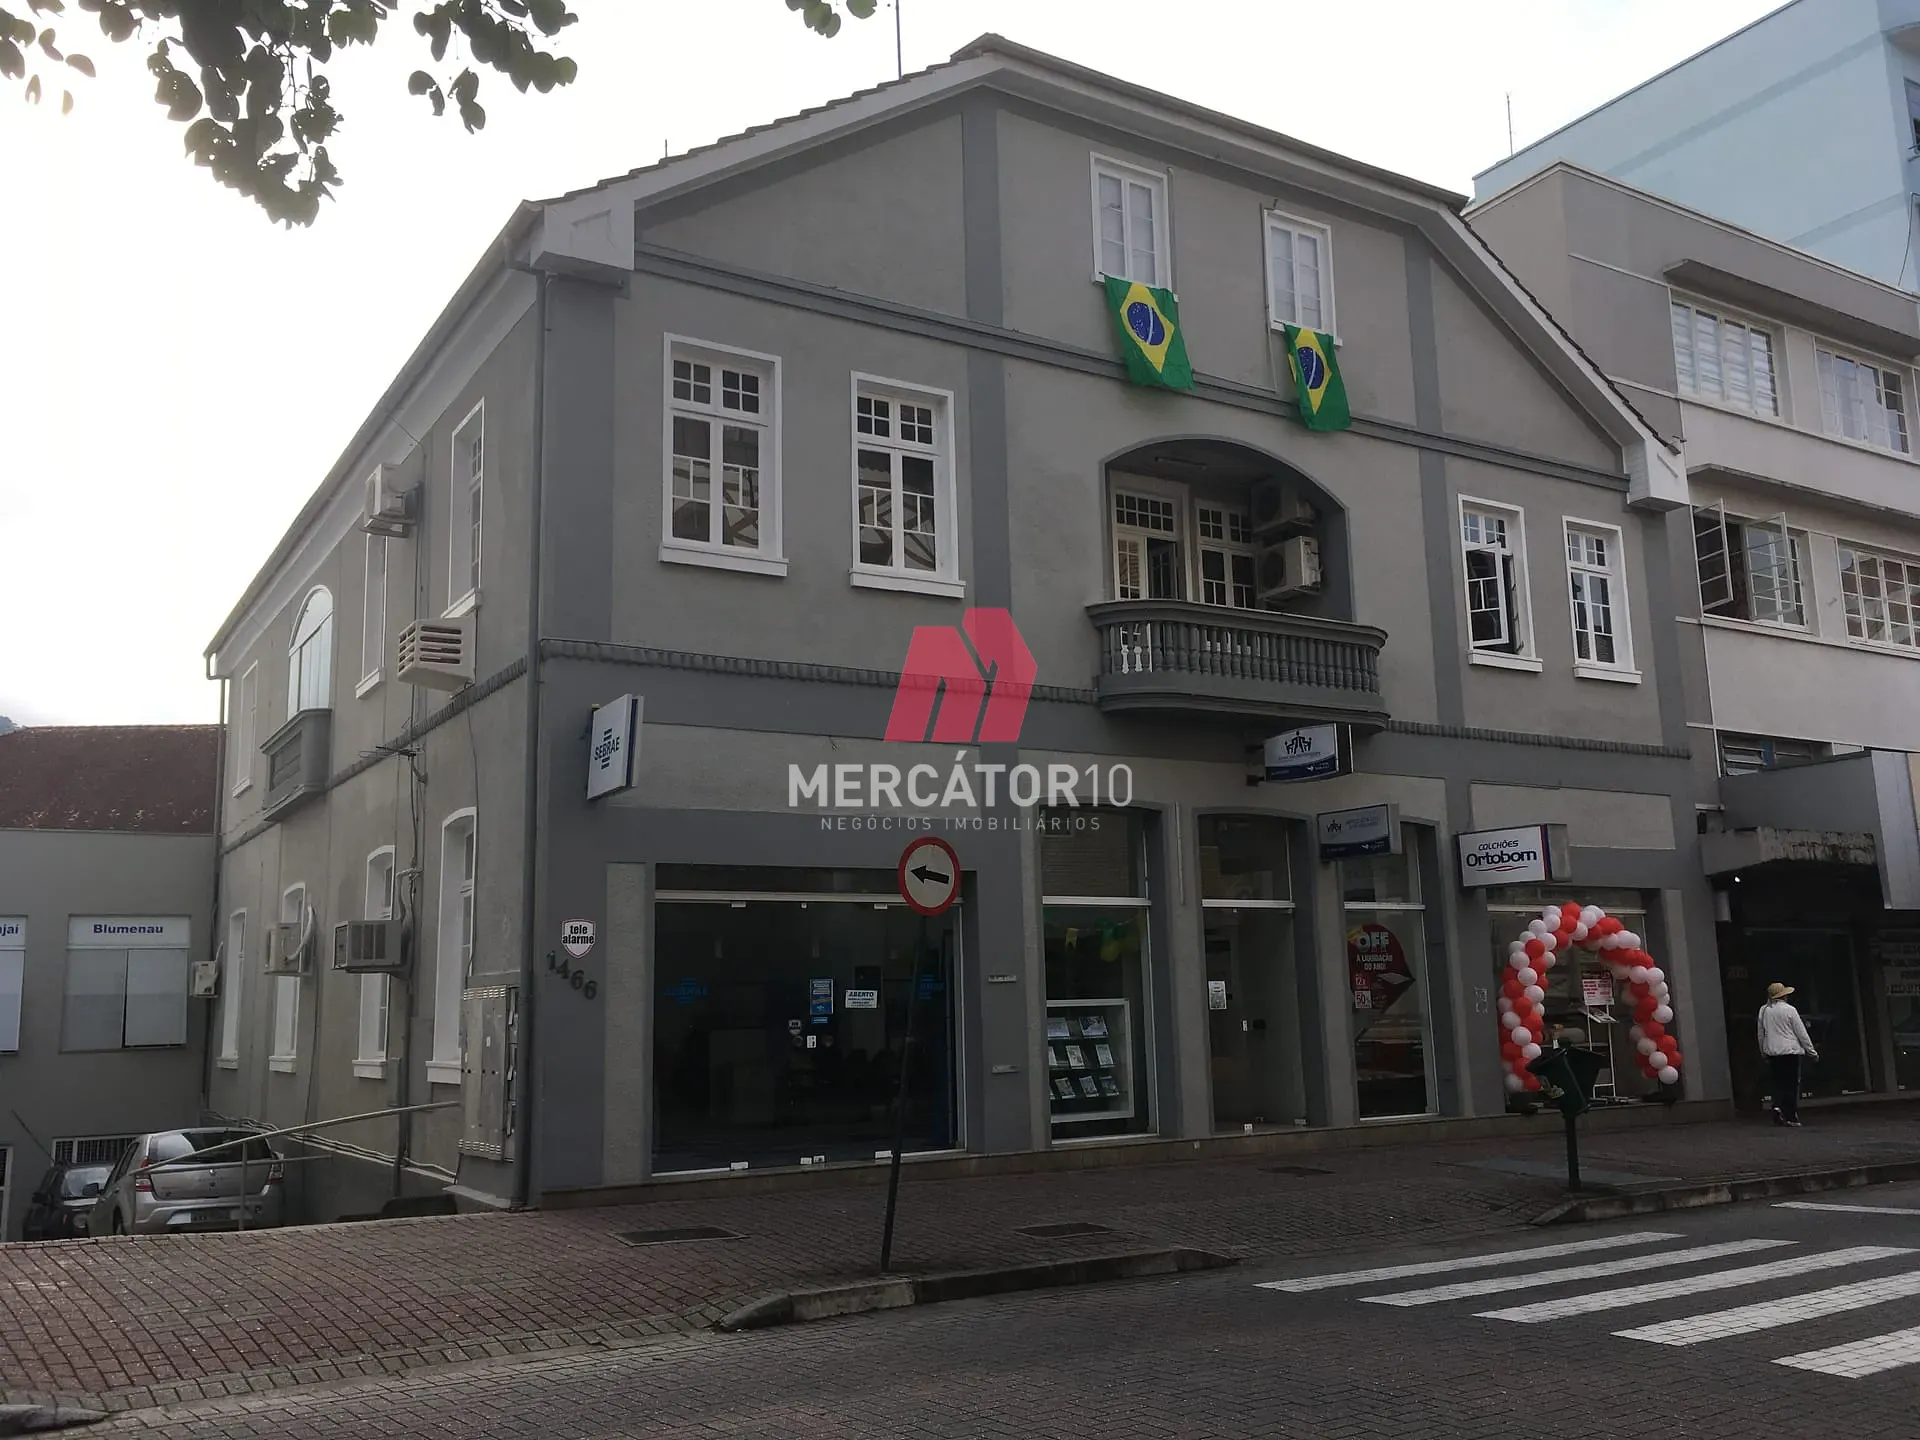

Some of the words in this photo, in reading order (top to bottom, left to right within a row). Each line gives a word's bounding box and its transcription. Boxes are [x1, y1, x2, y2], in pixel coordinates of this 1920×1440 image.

[594, 737, 620, 761] SEBRAE
[1478, 840, 1519, 851] COLCHÕES
[1466, 850, 1537, 867] Ortobom
[93, 923, 164, 934] Blumenau
[570, 924, 588, 935] tele
[562, 934, 594, 944] alarme
[546, 951, 598, 1000] 1466
